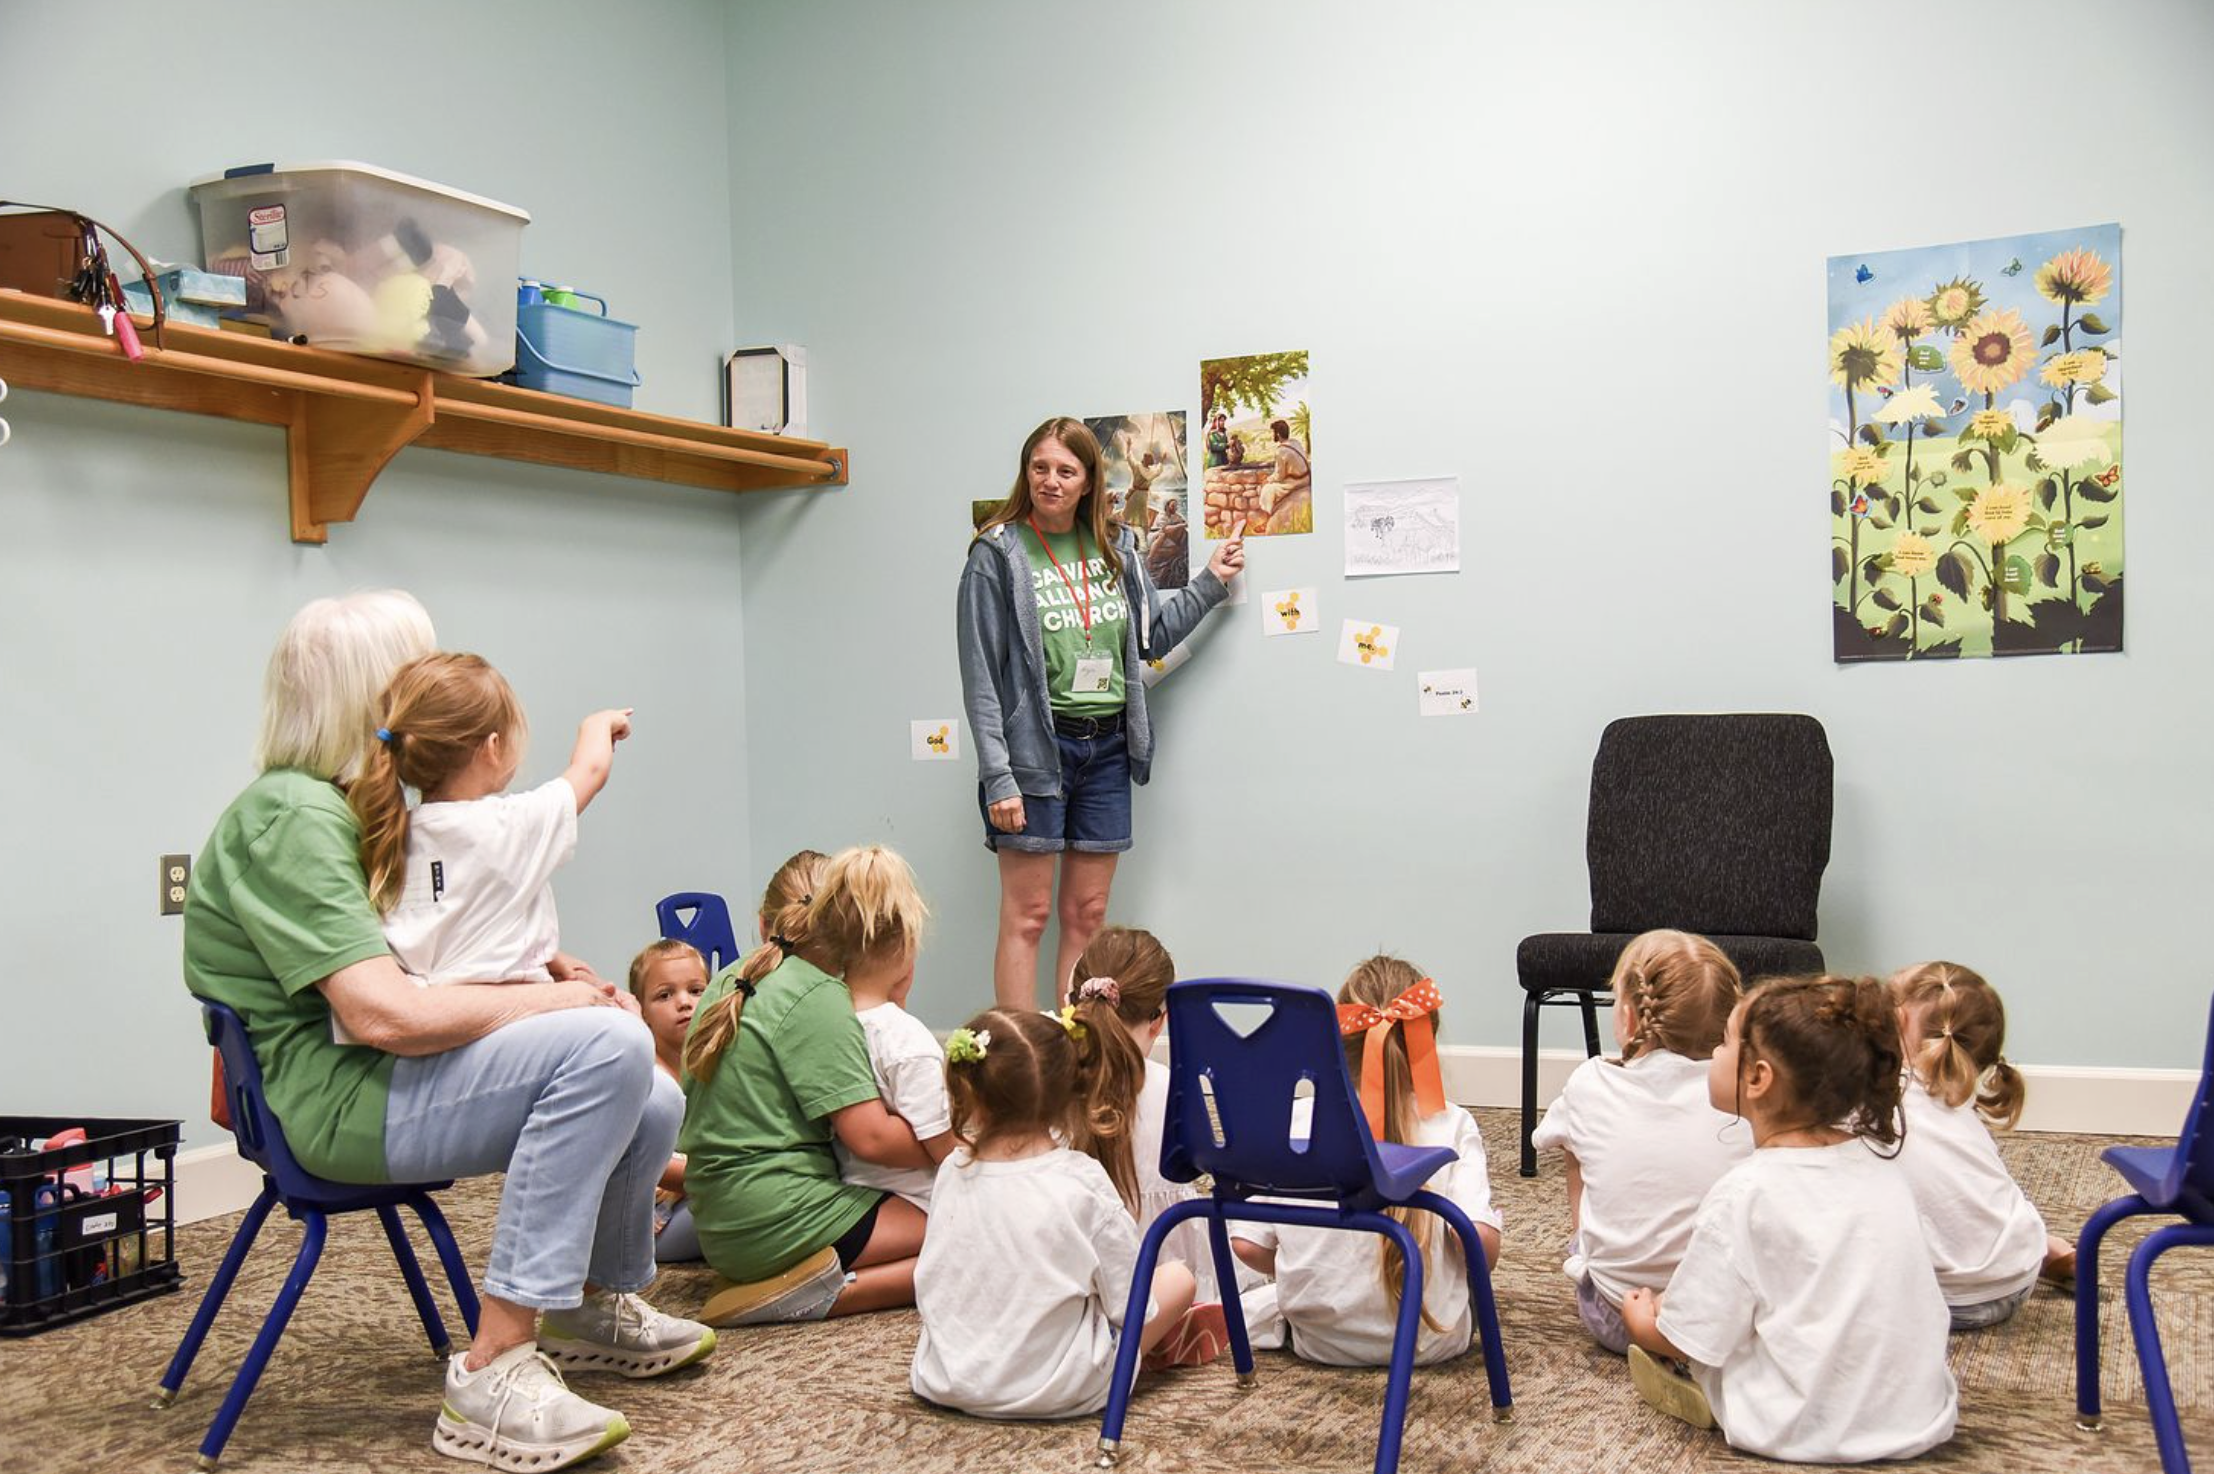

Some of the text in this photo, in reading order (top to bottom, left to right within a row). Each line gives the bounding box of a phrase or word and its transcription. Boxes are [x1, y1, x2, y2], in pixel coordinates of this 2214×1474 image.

[1035, 579, 1121, 609] ALLIANC
[1043, 600, 1127, 631] CHURCH
[1280, 607, 1300, 618] with
[926, 735, 944, 746] God
